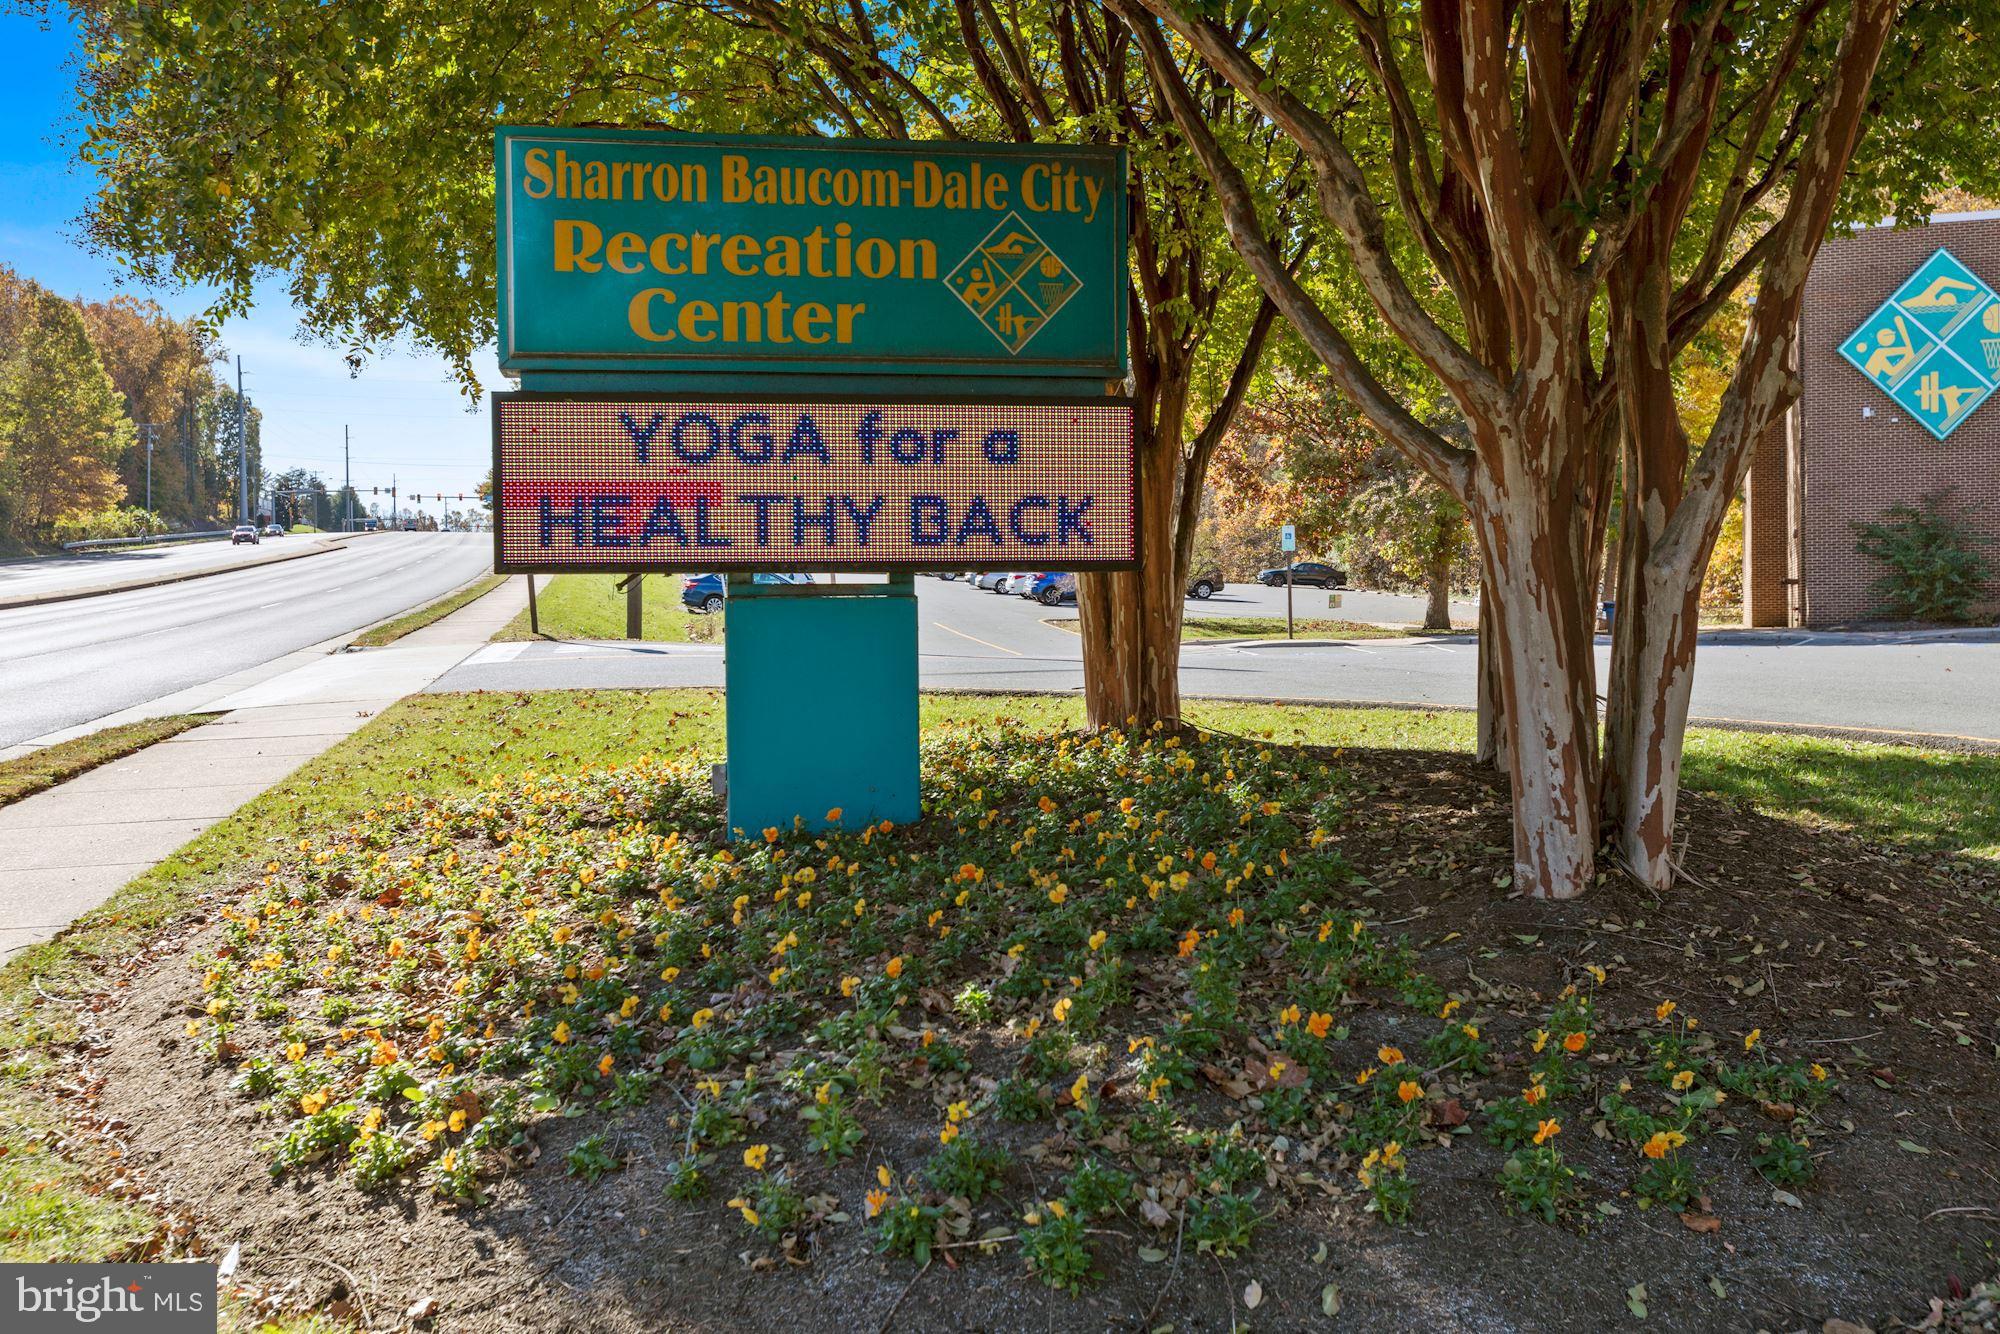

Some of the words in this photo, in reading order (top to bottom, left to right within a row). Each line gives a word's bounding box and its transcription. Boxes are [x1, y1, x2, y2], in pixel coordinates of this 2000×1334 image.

[523, 148, 707, 203] Sharron
[722, 155, 1008, 211] Baucom-Dale
[1020, 161, 1105, 223] City
[553, 219, 937, 280] Recreation
[628, 287, 867, 344] Center
[620, 411, 831, 465] YOGA
[858, 410, 958, 465] for
[982, 430, 1019, 465] a
[539, 495, 884, 548] HEALTHY
[912, 495, 1094, 547] BACK
